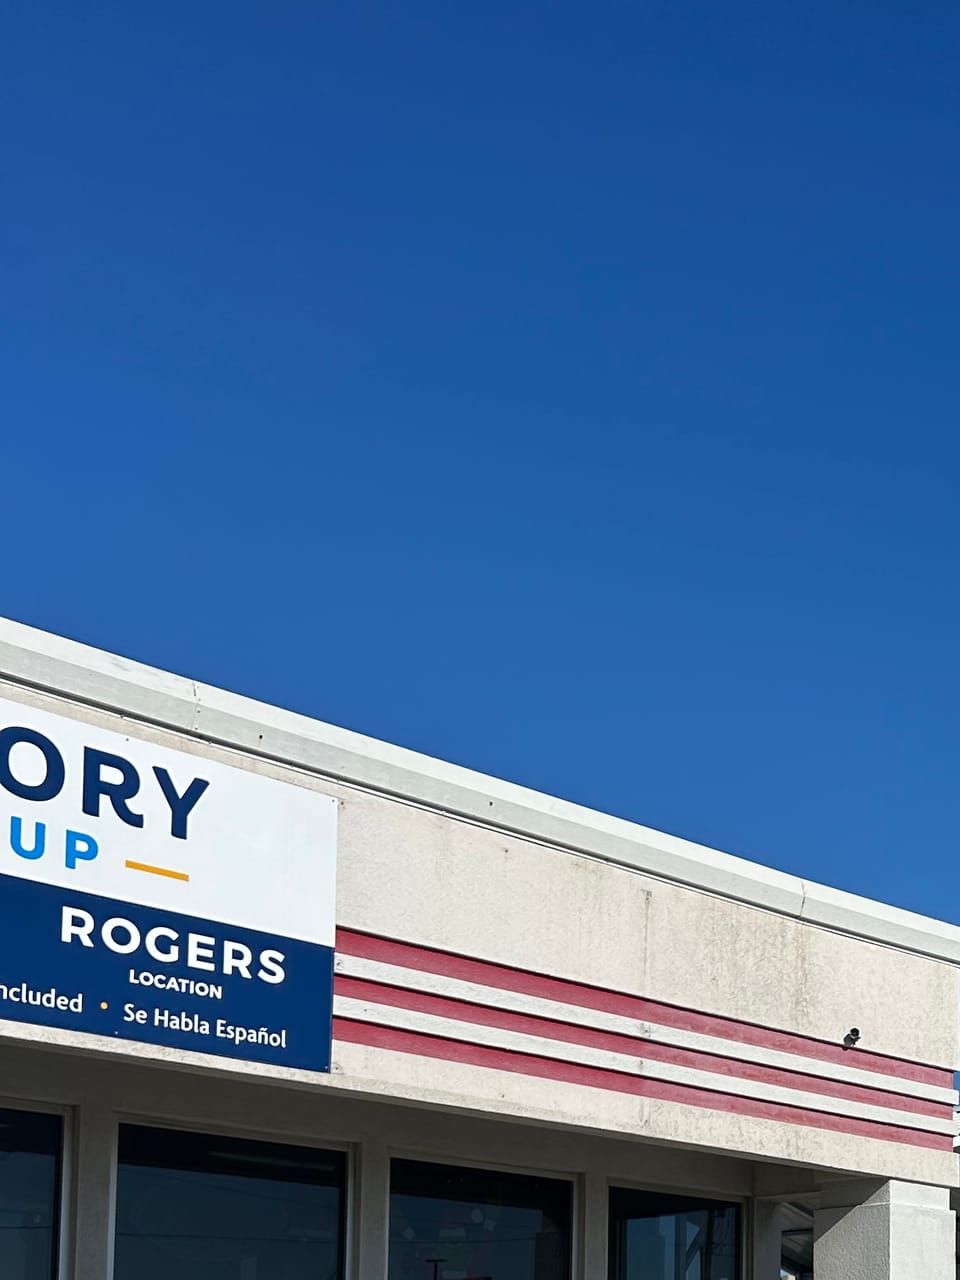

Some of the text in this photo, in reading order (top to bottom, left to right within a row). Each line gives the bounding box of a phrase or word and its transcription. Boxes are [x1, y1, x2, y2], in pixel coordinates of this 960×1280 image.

[0, 726, 210, 840] ORY
[10, 816, 99, 870] UP
[60, 905, 286, 984] ROGERS
[129, 968, 223, 1000] LOCATION
[123, 1003, 148, 1024] Se
[154, 1007, 210, 1036] Habla
[216, 1019, 287, 1048] Español
